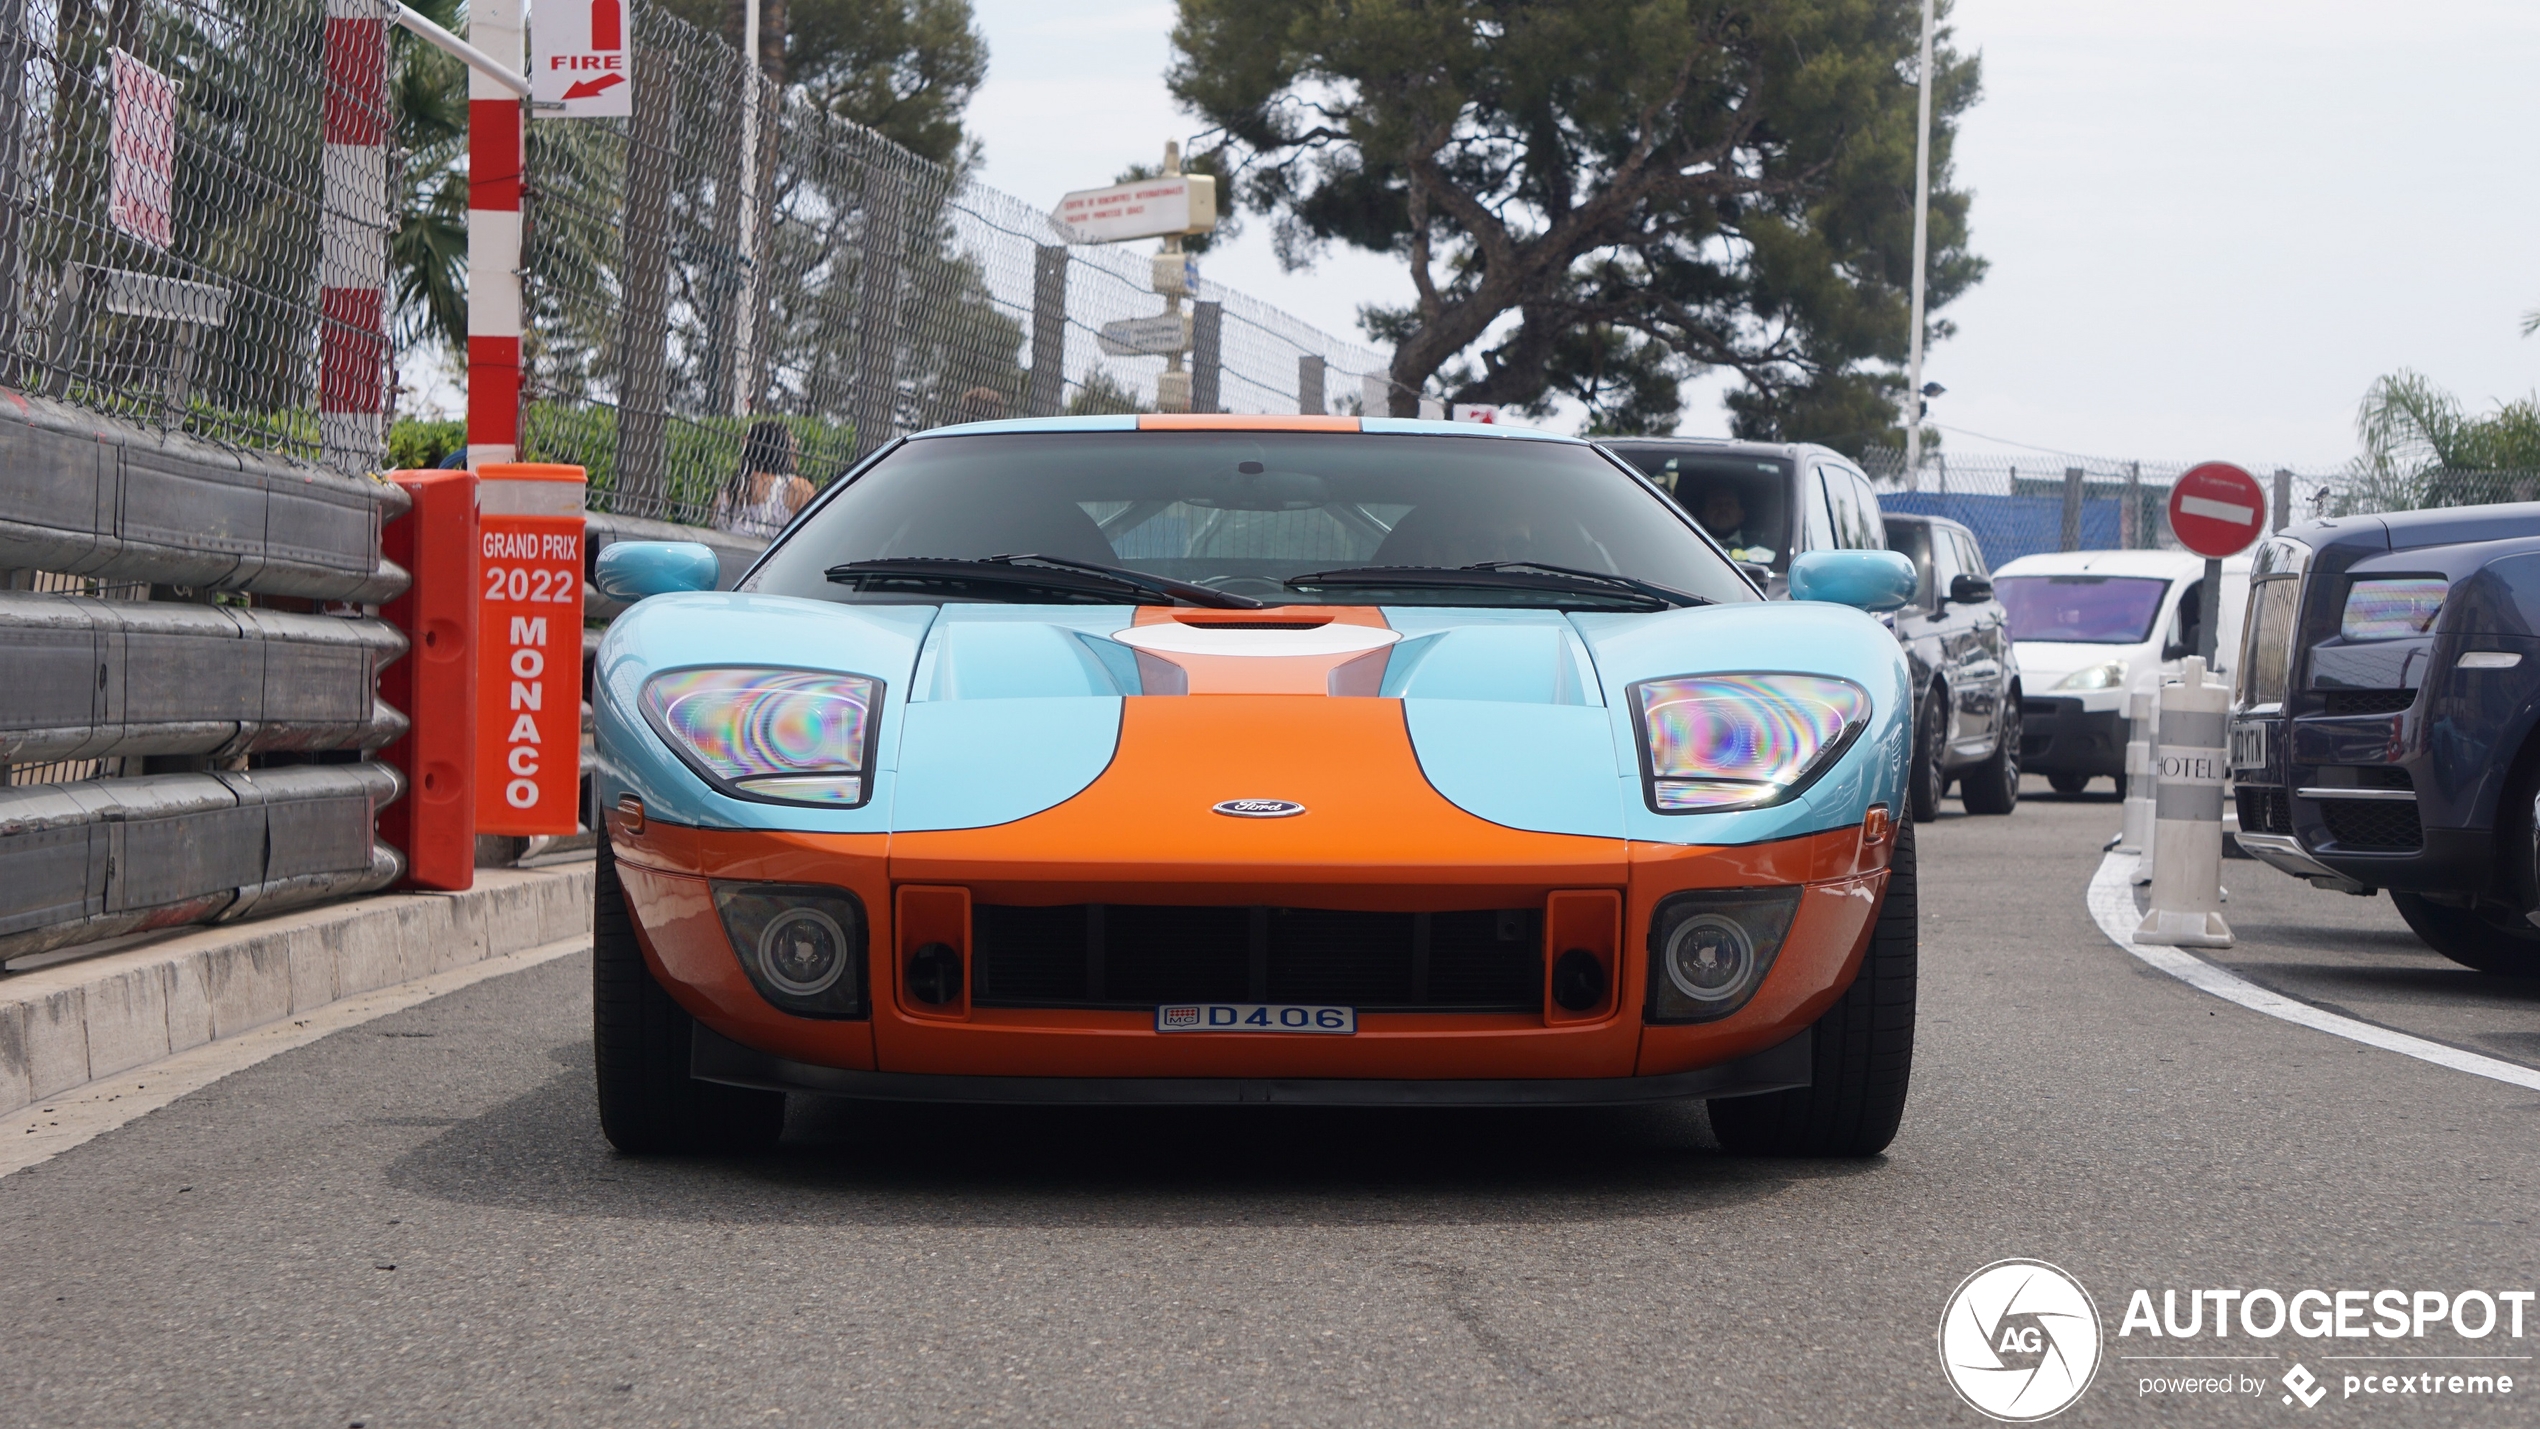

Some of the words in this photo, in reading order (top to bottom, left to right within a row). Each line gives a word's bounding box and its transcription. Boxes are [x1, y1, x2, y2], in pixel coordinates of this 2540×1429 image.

[551, 55, 622, 70] FIRE
[483, 532, 538, 559] GRAND
[542, 534, 577, 560] PRIX
[485, 567, 573, 603] 2022
[506, 616, 547, 809] MONACO
[1235, 801, 1282, 811] Ford
[1208, 1007, 1345, 1028] D406
